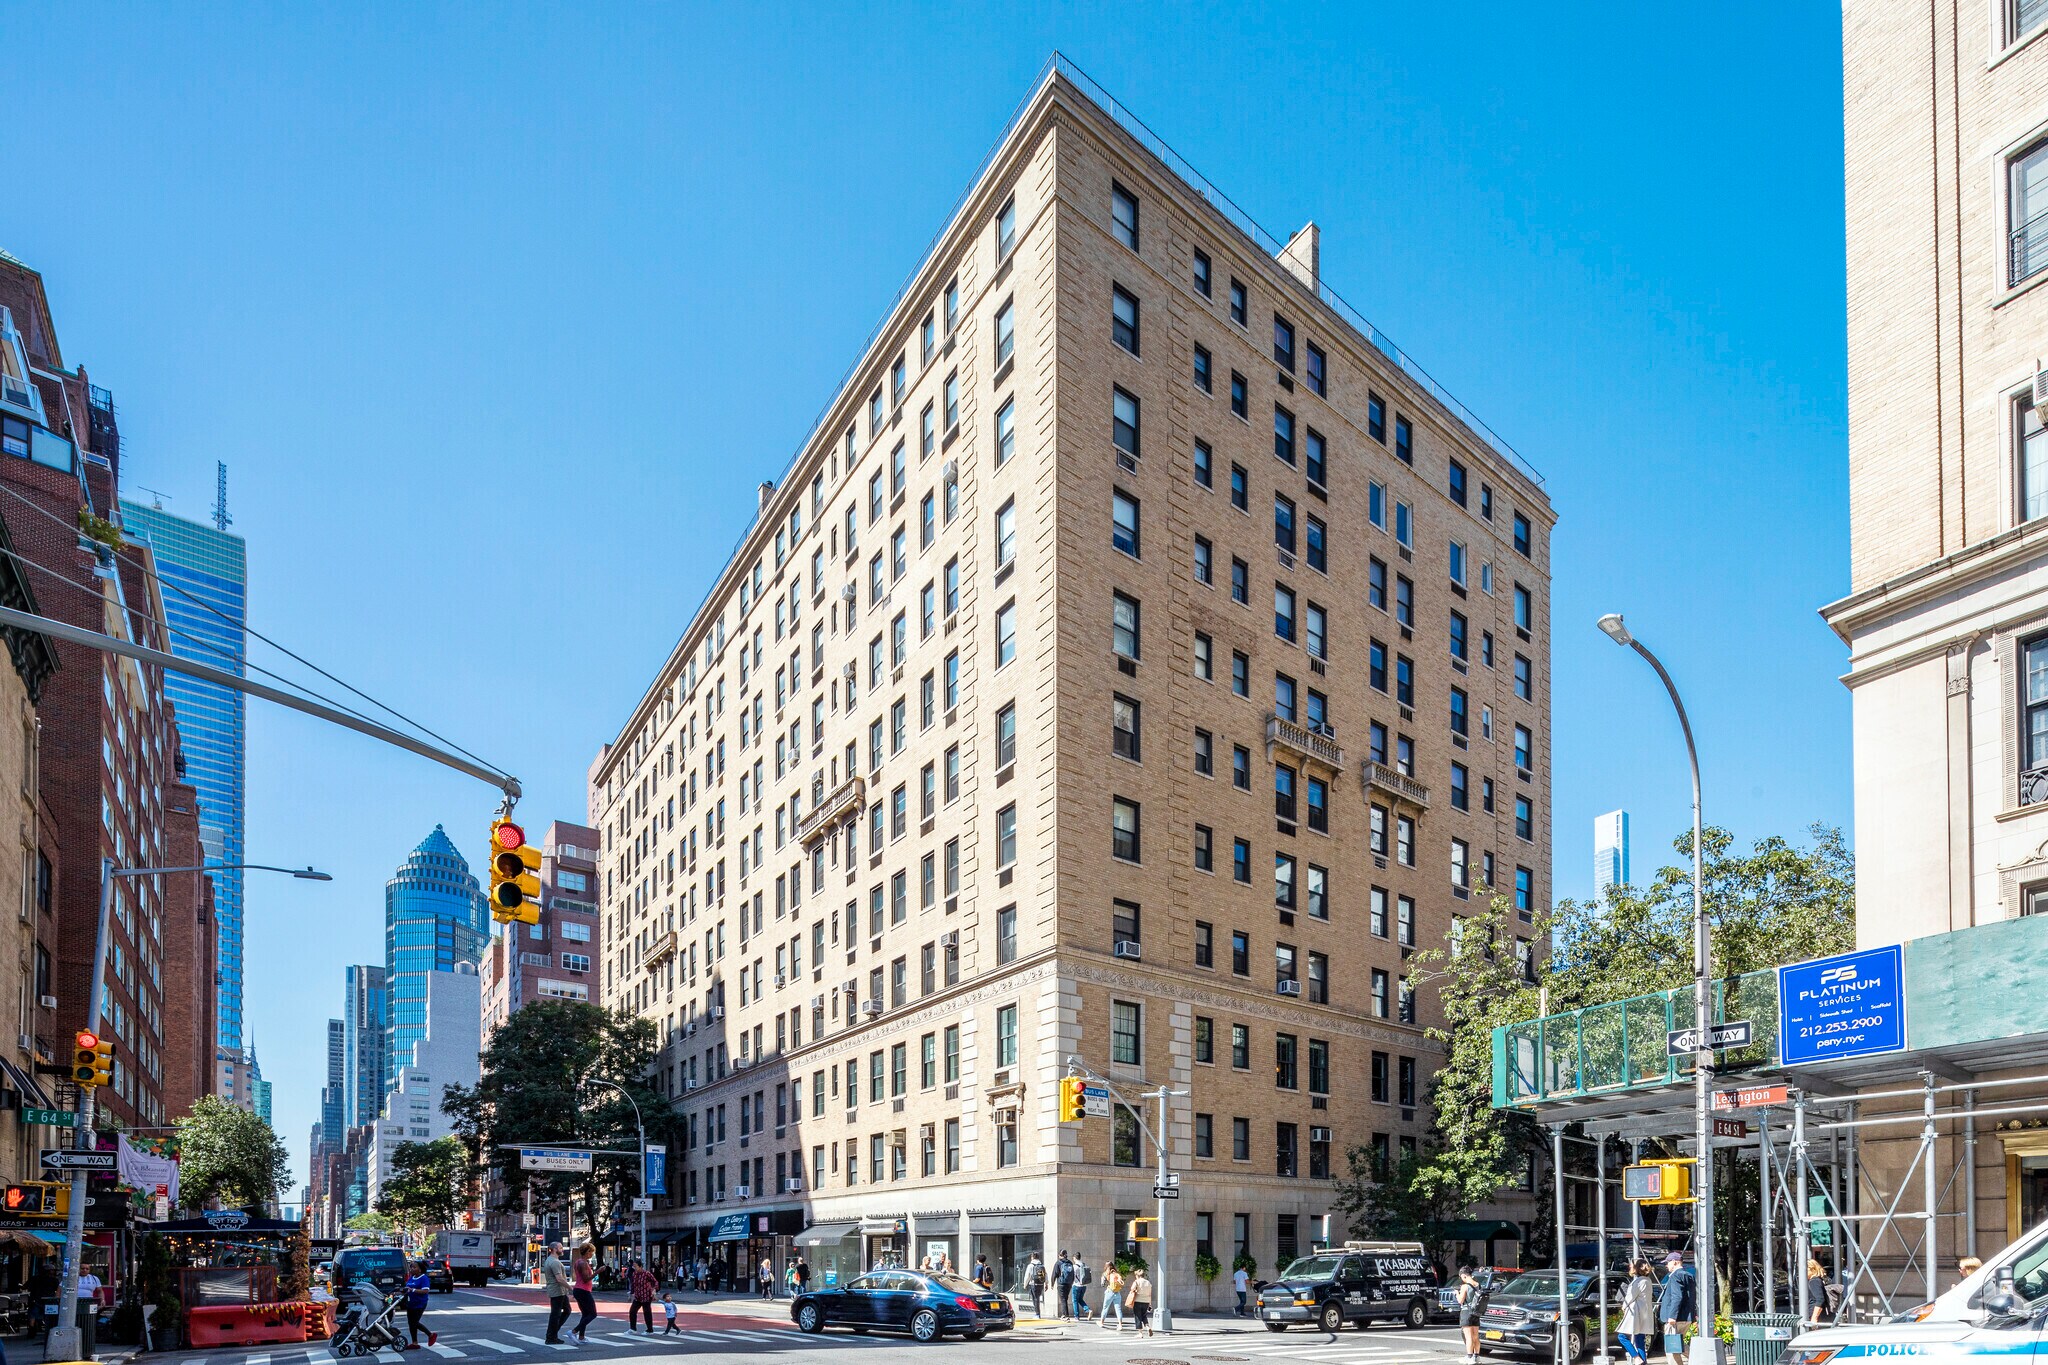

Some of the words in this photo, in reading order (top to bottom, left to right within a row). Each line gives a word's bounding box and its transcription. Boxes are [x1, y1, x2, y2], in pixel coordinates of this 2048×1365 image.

[1821, 964, 1857, 985] PS
[1799, 977, 1881, 1001] PLATINUM
[1818, 995, 1861, 1008] SERVICES
[1819, 1010, 1840, 1018] Sidewalk
[1870, 1002, 1892, 1010] Scaffold
[1799, 1015, 1883, 1038] 212.253.2900
[1680, 1036, 1696, 1047] ON
[1714, 1029, 1740, 1042] WAY
[1816, 1034, 1865, 1050] psny.nyc
[1716, 1090, 1770, 1105] Lexington
[27, 1110, 34, 1122] E
[41, 1111, 57, 1123] 64
[63, 1112, 71, 1121] St
[1718, 1122, 1722, 1134] E
[1723, 1122, 1732, 1135] 64
[1733, 1124, 1740, 1136] St
[51, 1155, 74, 1164] ONE
[87, 1156, 111, 1164] WAY
[1383, 1258, 1424, 1270] KABACK
[1395, 1284, 1420, 1292] 645-5100
[1866, 1344, 1929, 1357] POLICE
